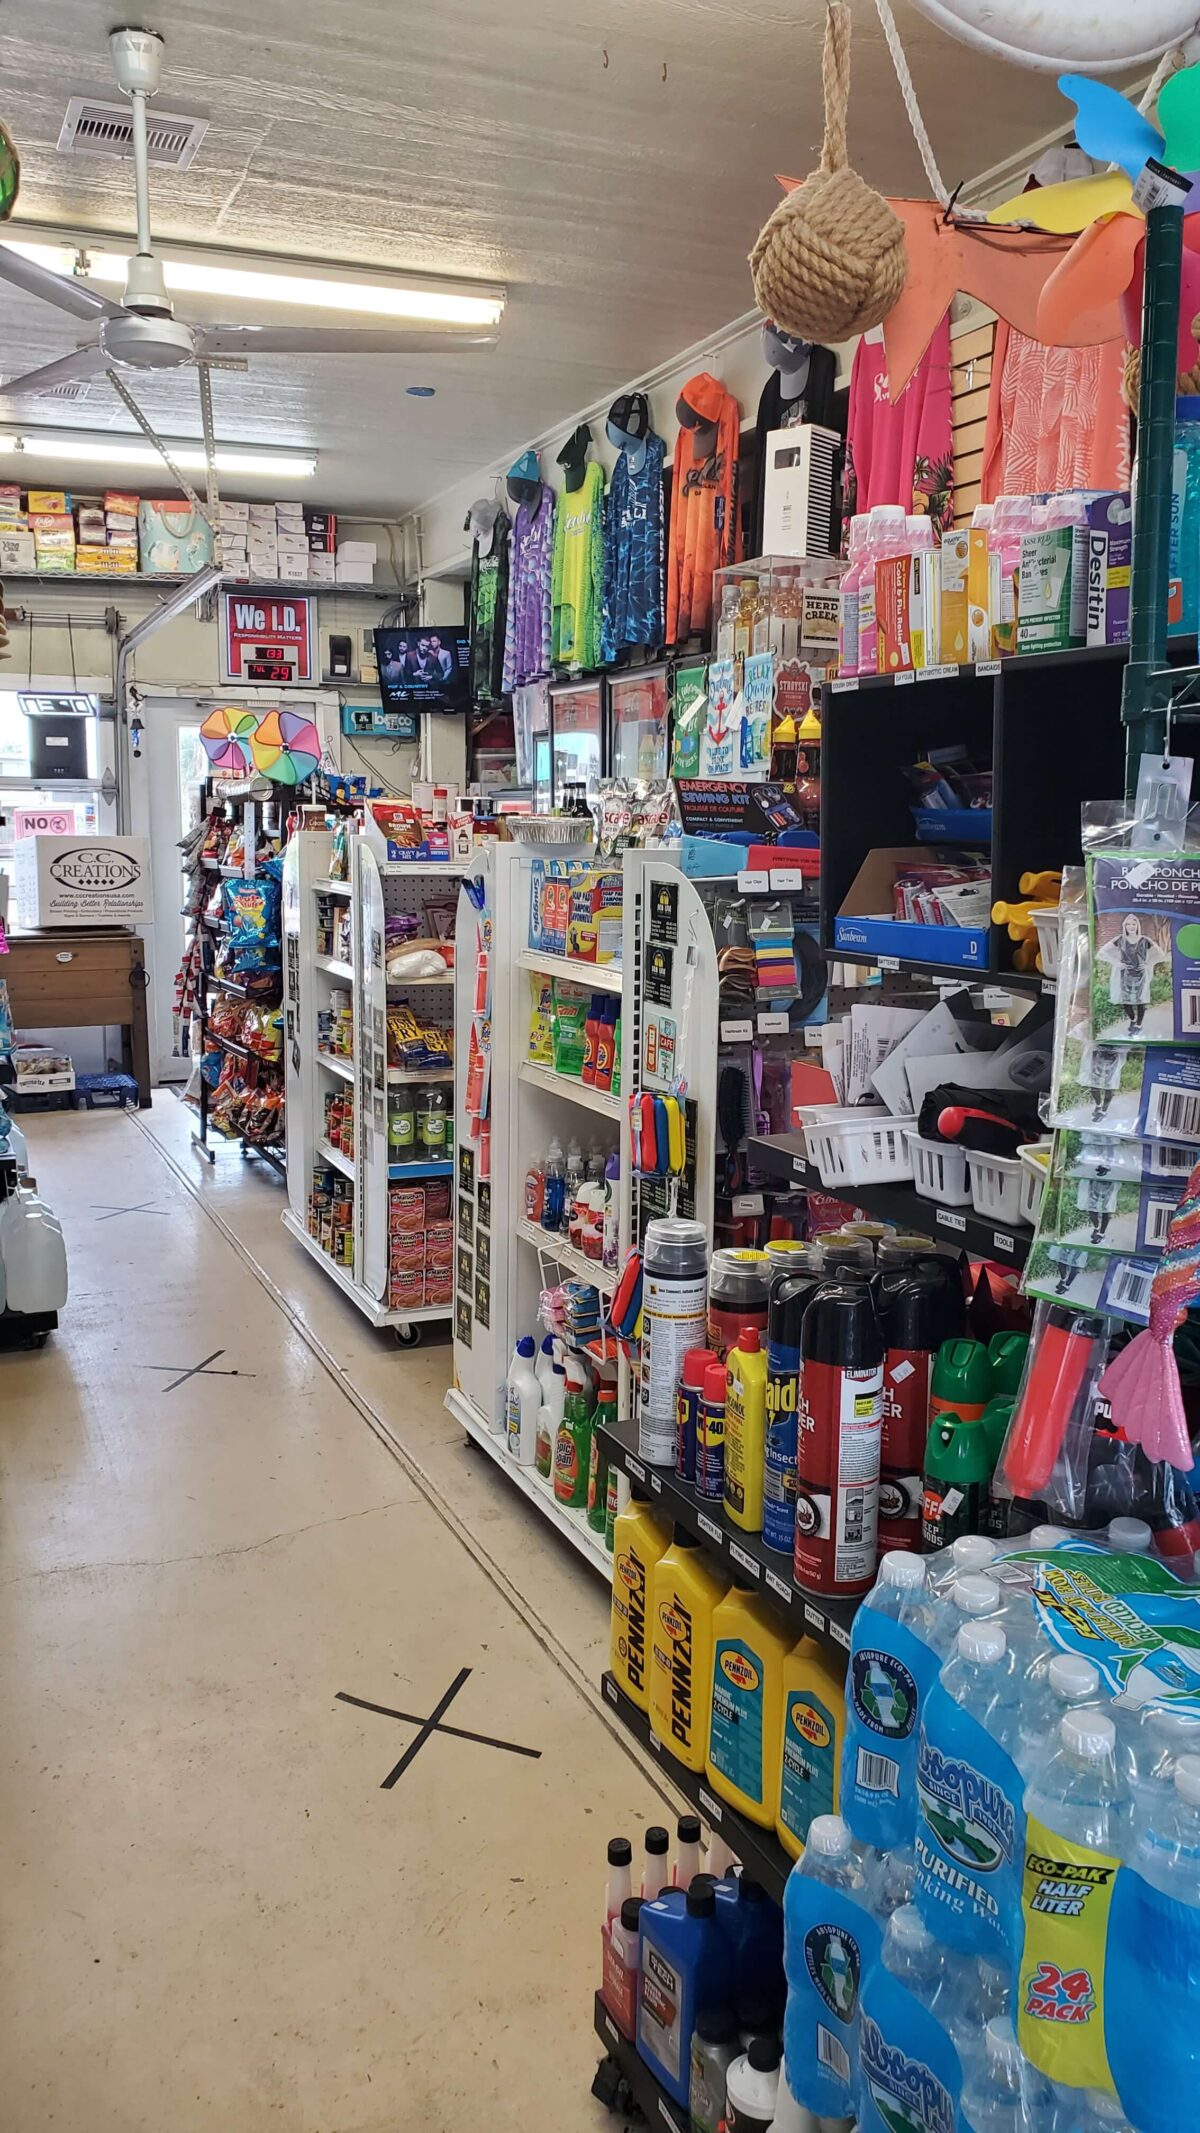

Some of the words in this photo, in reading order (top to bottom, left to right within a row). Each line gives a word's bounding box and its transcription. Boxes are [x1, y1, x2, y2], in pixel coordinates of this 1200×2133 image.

[1170, 493, 1180, 524] SUN
[1022, 550, 1037, 558] Sheer
[1169, 529, 1180, 577] AFTER
[1088, 535, 1106, 630] Desitin
[806, 601, 838, 611] HERD
[234, 603, 266, 630] We
[271, 605, 301, 632] I.D.
[805, 611, 838, 623] CREEK
[233, 632, 277, 640] RESPONSIBILITY
[1020, 629, 1029, 638] 40
[271, 667, 289, 680] 29
[918, 669, 942, 677] ANTIBIOTIC
[679, 780, 748, 794] EMERGENCY
[682, 793, 730, 804] SEWING
[732, 793, 750, 805] KIT
[24, 817, 49, 831] NO
[77, 852, 114, 864] C.C.
[49, 864, 141, 879] CREATIONS
[1154, 867, 1200, 879] PONCH
[1172, 881, 1189, 892] DE
[49, 899, 78, 909] Building
[80, 899, 101, 908] Better
[103, 898, 144, 909] Relationships
[532, 877, 540, 932] Snuggle
[836, 926, 867, 944] Sunbeam
[970, 941, 978, 953] D
[878, 958, 899, 967] BATTERIES
[557, 1006, 578, 1016] Gain
[387, 1018, 415, 1030] FISH
[391, 1029, 419, 1040] FRY
[423, 1032, 442, 1042] ISH
[660, 1036, 673, 1050] CAFE
[937, 1211, 954, 1225] CABLE
[954, 1216, 966, 1229] TIES
[397, 1233, 423, 1241] Maruchan
[432, 1229, 453, 1237] Marucha
[995, 1235, 1014, 1249] TOOLS
[397, 1272, 423, 1281] Maruchan
[431, 1268, 453, 1276] Marucha
[846, 1367, 877, 1379] ELIMINATOR
[766, 1377, 796, 1413] aid
[770, 1448, 798, 1465] Insect
[924, 1497, 943, 1520] FF!
[730, 1543, 745, 1564] FLYING
[744, 1555, 759, 1574] INSECT
[619, 1562, 638, 1582] PENNZOIL
[766, 1569, 776, 1585] ANT
[776, 1576, 791, 1599] ROACH
[661, 1610, 682, 1633] PENNZOIL
[805, 1607, 825, 1628] CUTTER
[1103, 1600, 1160, 1640] RECYCLED
[831, 1622, 844, 1640] DEEP
[724, 1659, 754, 1681] PENNZOIL
[714, 1682, 733, 1698] MARINE
[713, 1700, 733, 1721] 2-CYCLE
[734, 1703, 748, 1720] PLUS
[854, 1701, 867, 1723] MADE
[866, 1721, 884, 1735] FROM
[795, 1711, 826, 1737] PENNZOIL
[784, 1754, 805, 1778] 2-CYCLE
[928, 1781, 958, 1804] SINCE
[915, 1837, 999, 1916] PURIFIED
[1027, 1857, 1109, 1883] ECO-PAK
[1037, 1879, 1093, 1901] HALF
[1030, 1895, 1085, 1917] LITER
[815, 1926, 848, 1941] ABSOPURE
[1030, 1963, 1092, 2002] 24
[1025, 1998, 1097, 2024] PACK
[888, 2079, 919, 2103] SINCE
